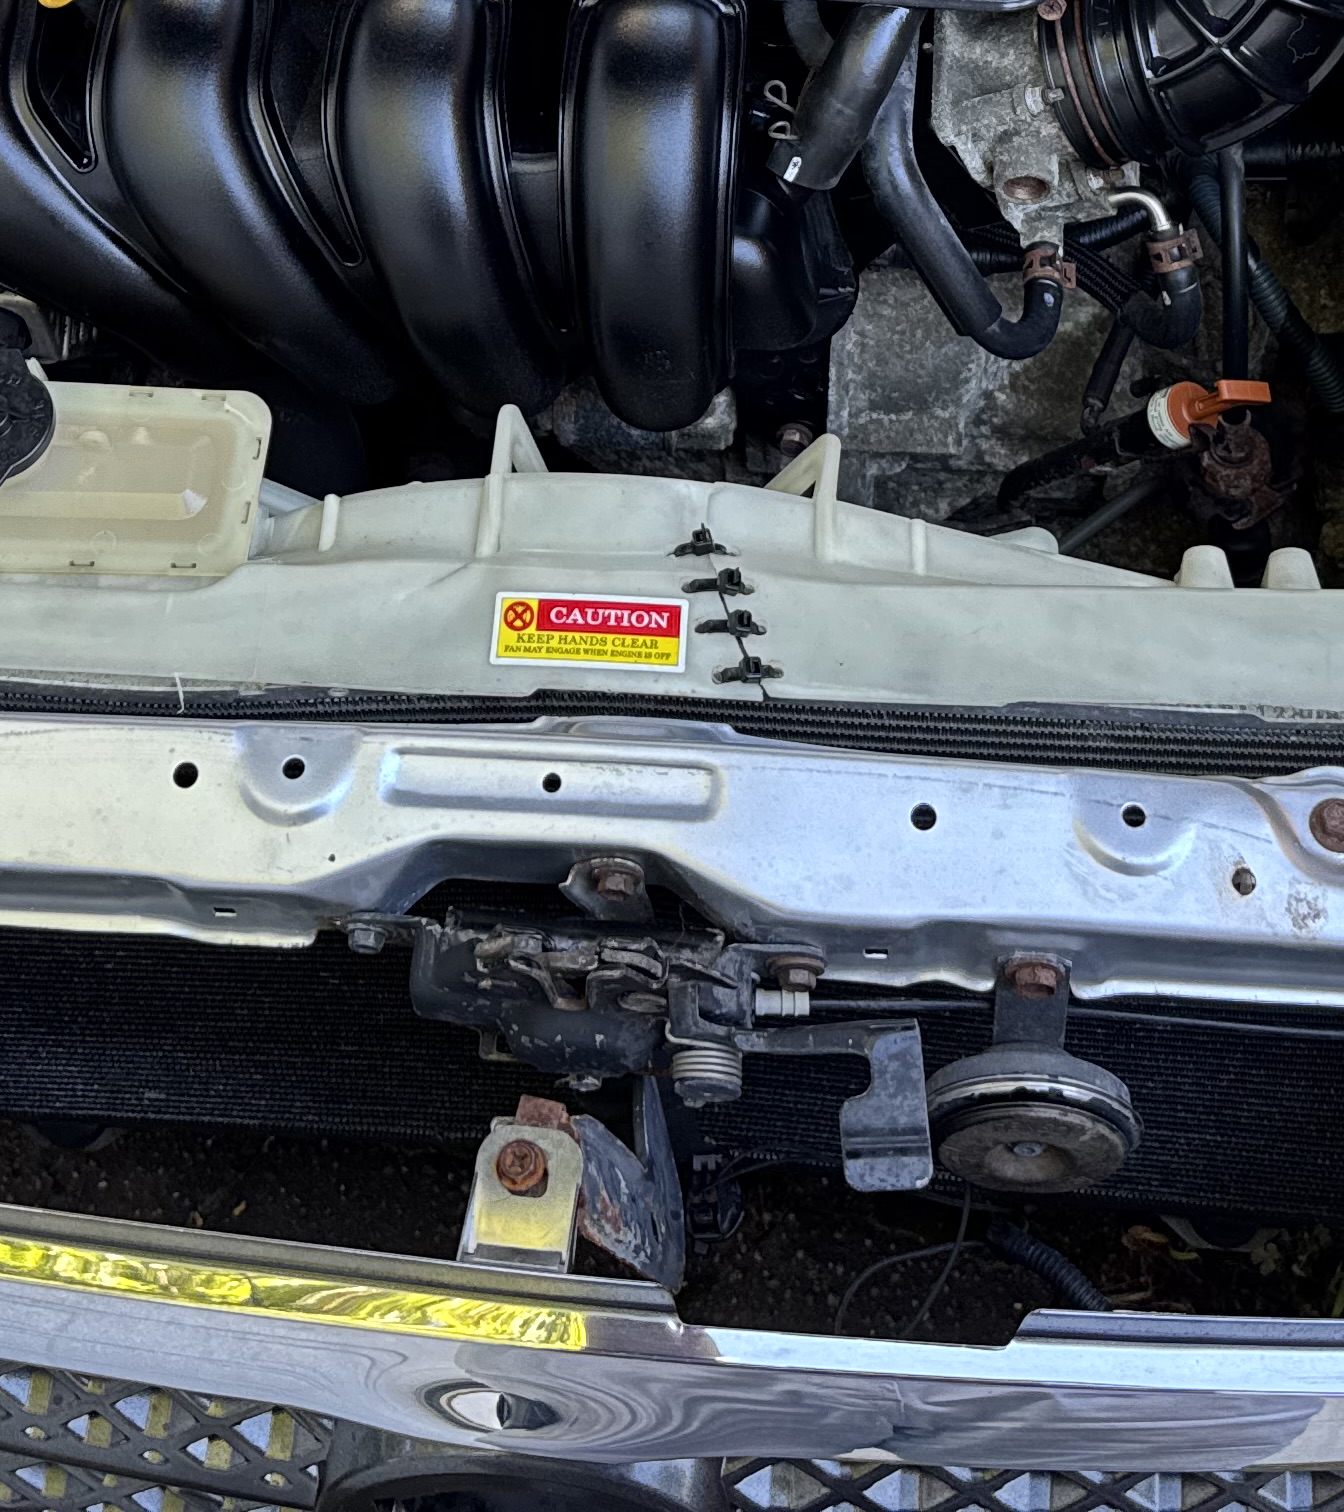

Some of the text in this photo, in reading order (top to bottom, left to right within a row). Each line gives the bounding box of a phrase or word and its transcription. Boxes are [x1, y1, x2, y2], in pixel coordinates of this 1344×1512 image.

[549, 606, 670, 629] CAUTION
[516, 633, 659, 649] KEEP HANDS CLEAR
[503, 644, 672, 660] FAN MAY ENGAGE WHEN ENGINE IS OFF
